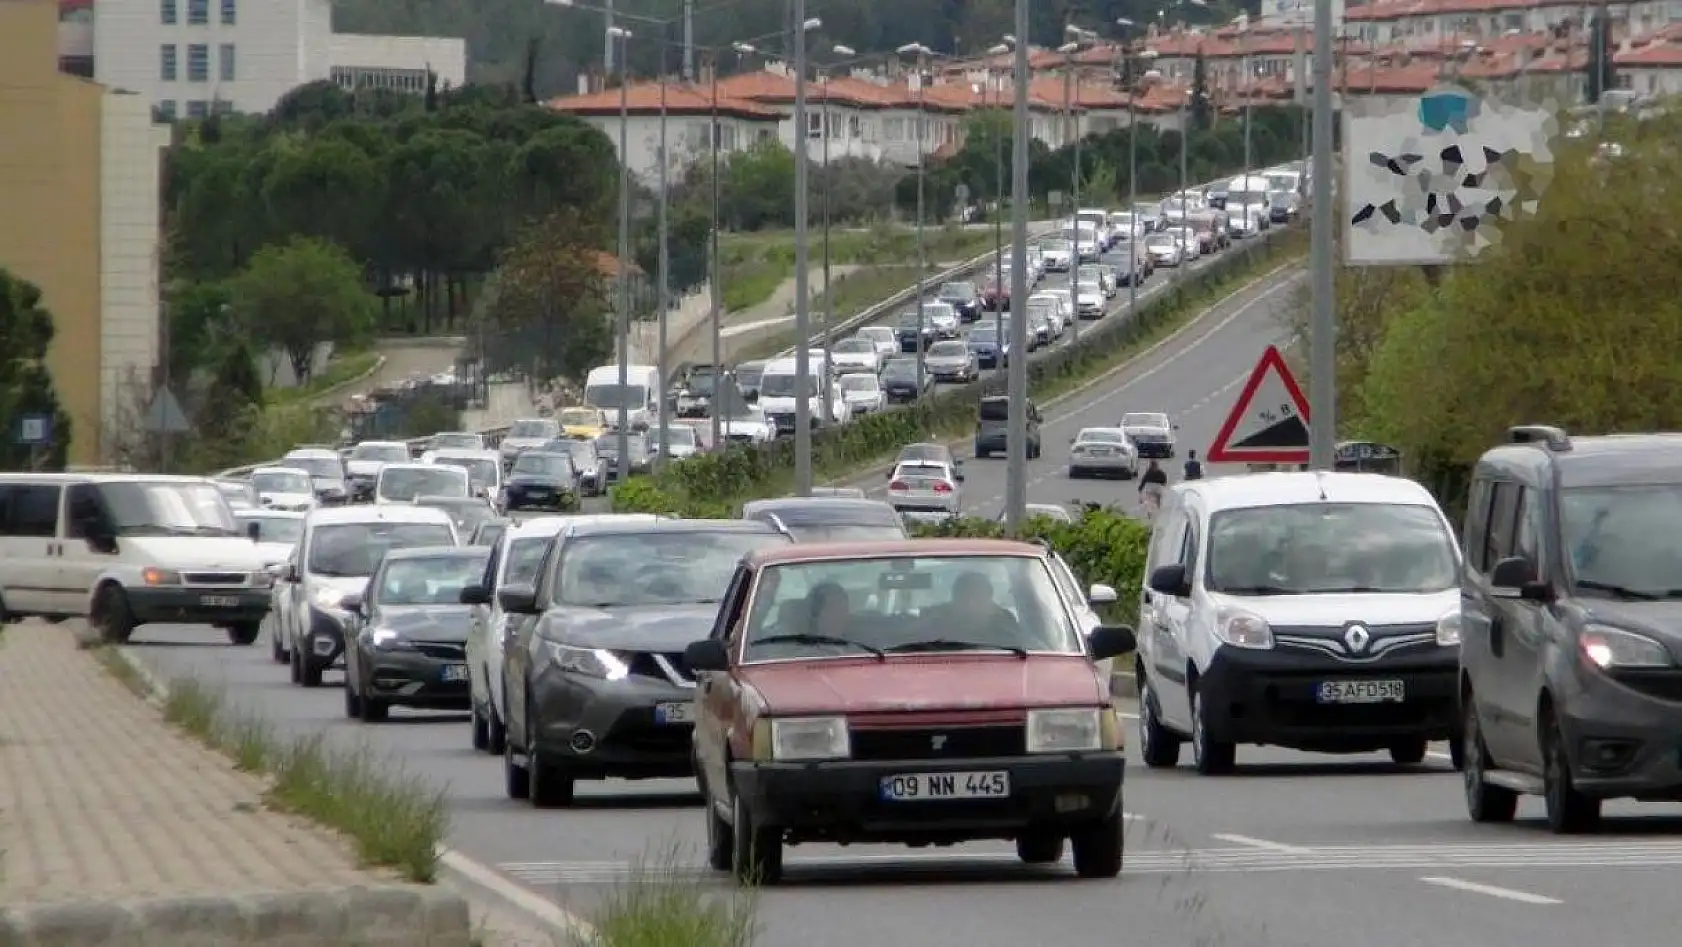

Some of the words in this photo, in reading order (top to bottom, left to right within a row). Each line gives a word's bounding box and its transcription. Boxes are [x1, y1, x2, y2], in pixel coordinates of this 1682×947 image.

[894, 777, 918, 796] 09
[927, 775, 955, 796] NN
[966, 773, 1005, 795] 445
